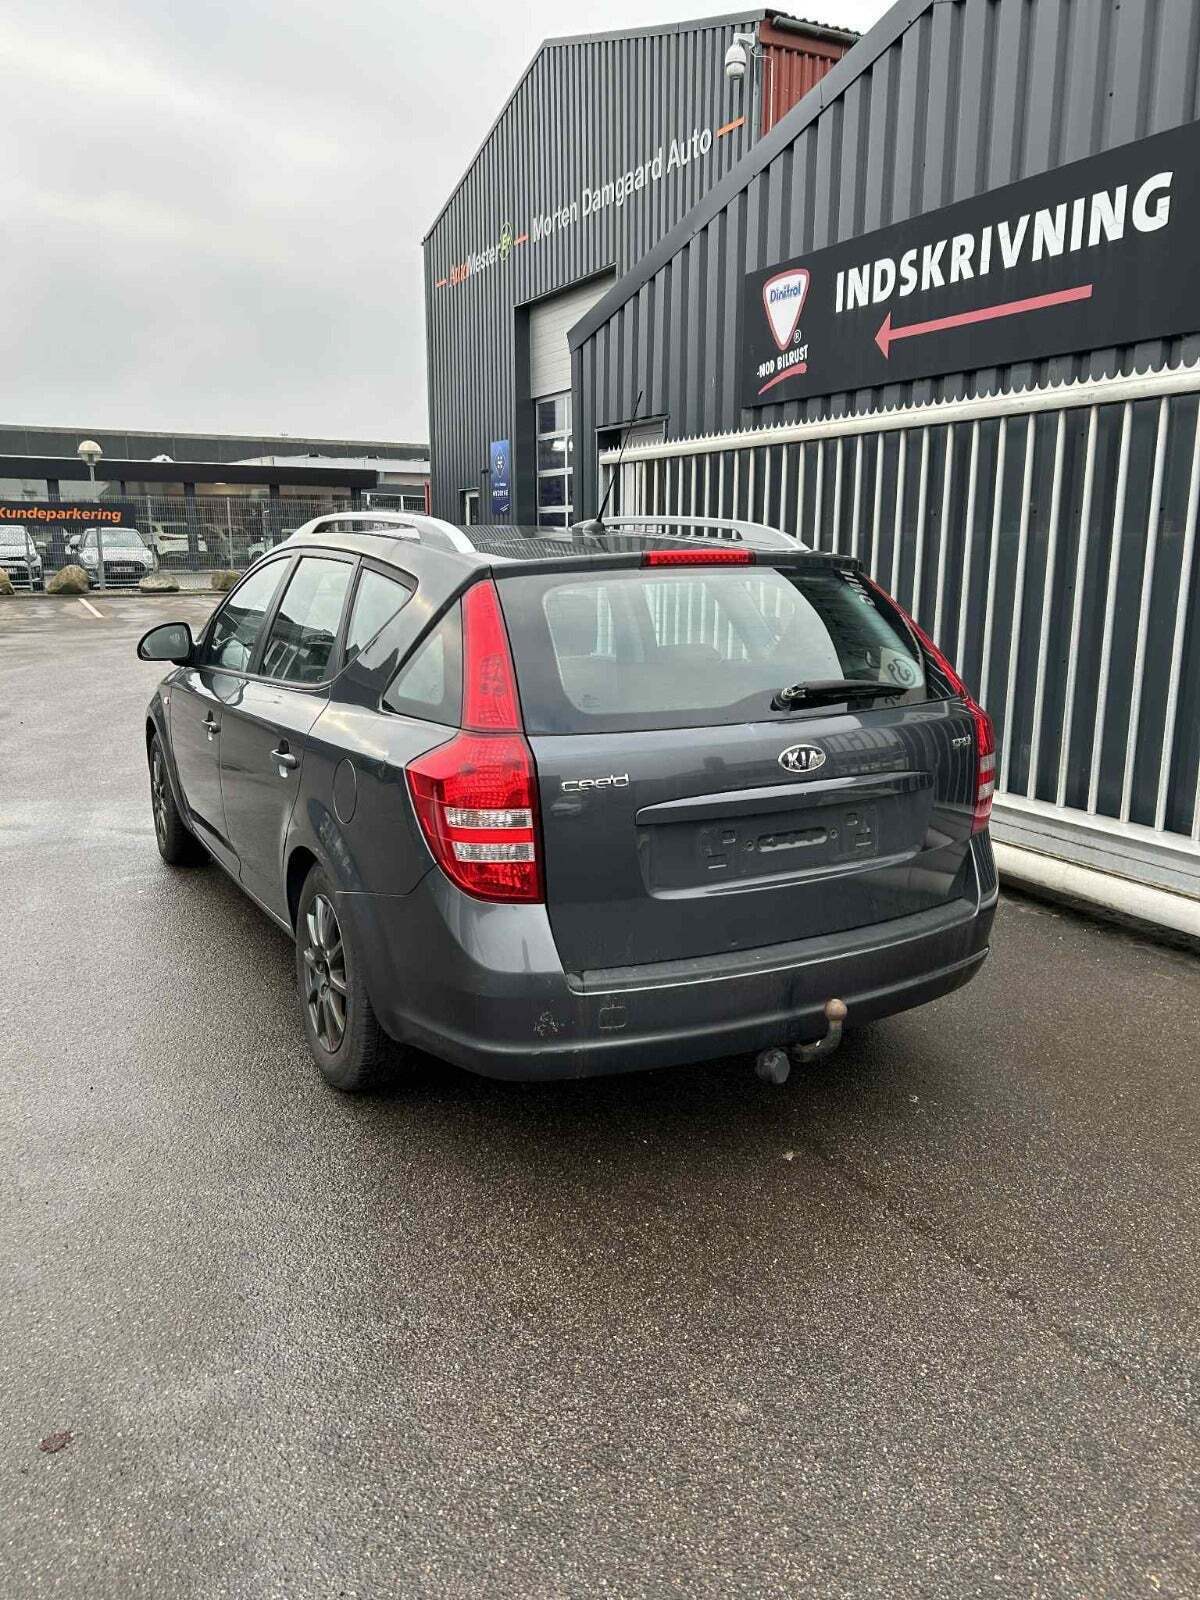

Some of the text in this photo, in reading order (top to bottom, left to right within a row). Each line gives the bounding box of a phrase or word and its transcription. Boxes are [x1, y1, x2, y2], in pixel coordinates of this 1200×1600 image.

[532, 127, 712, 242] Morten Damgaard Auto
[835, 171, 1174, 313] INDSKRIVNING
[769, 280, 801, 304] Dinitrol
[777, 344, 809, 370] BILRUST
[0, 506, 122, 523] Kundeparkering
[786, 749, 821, 770] KIA
